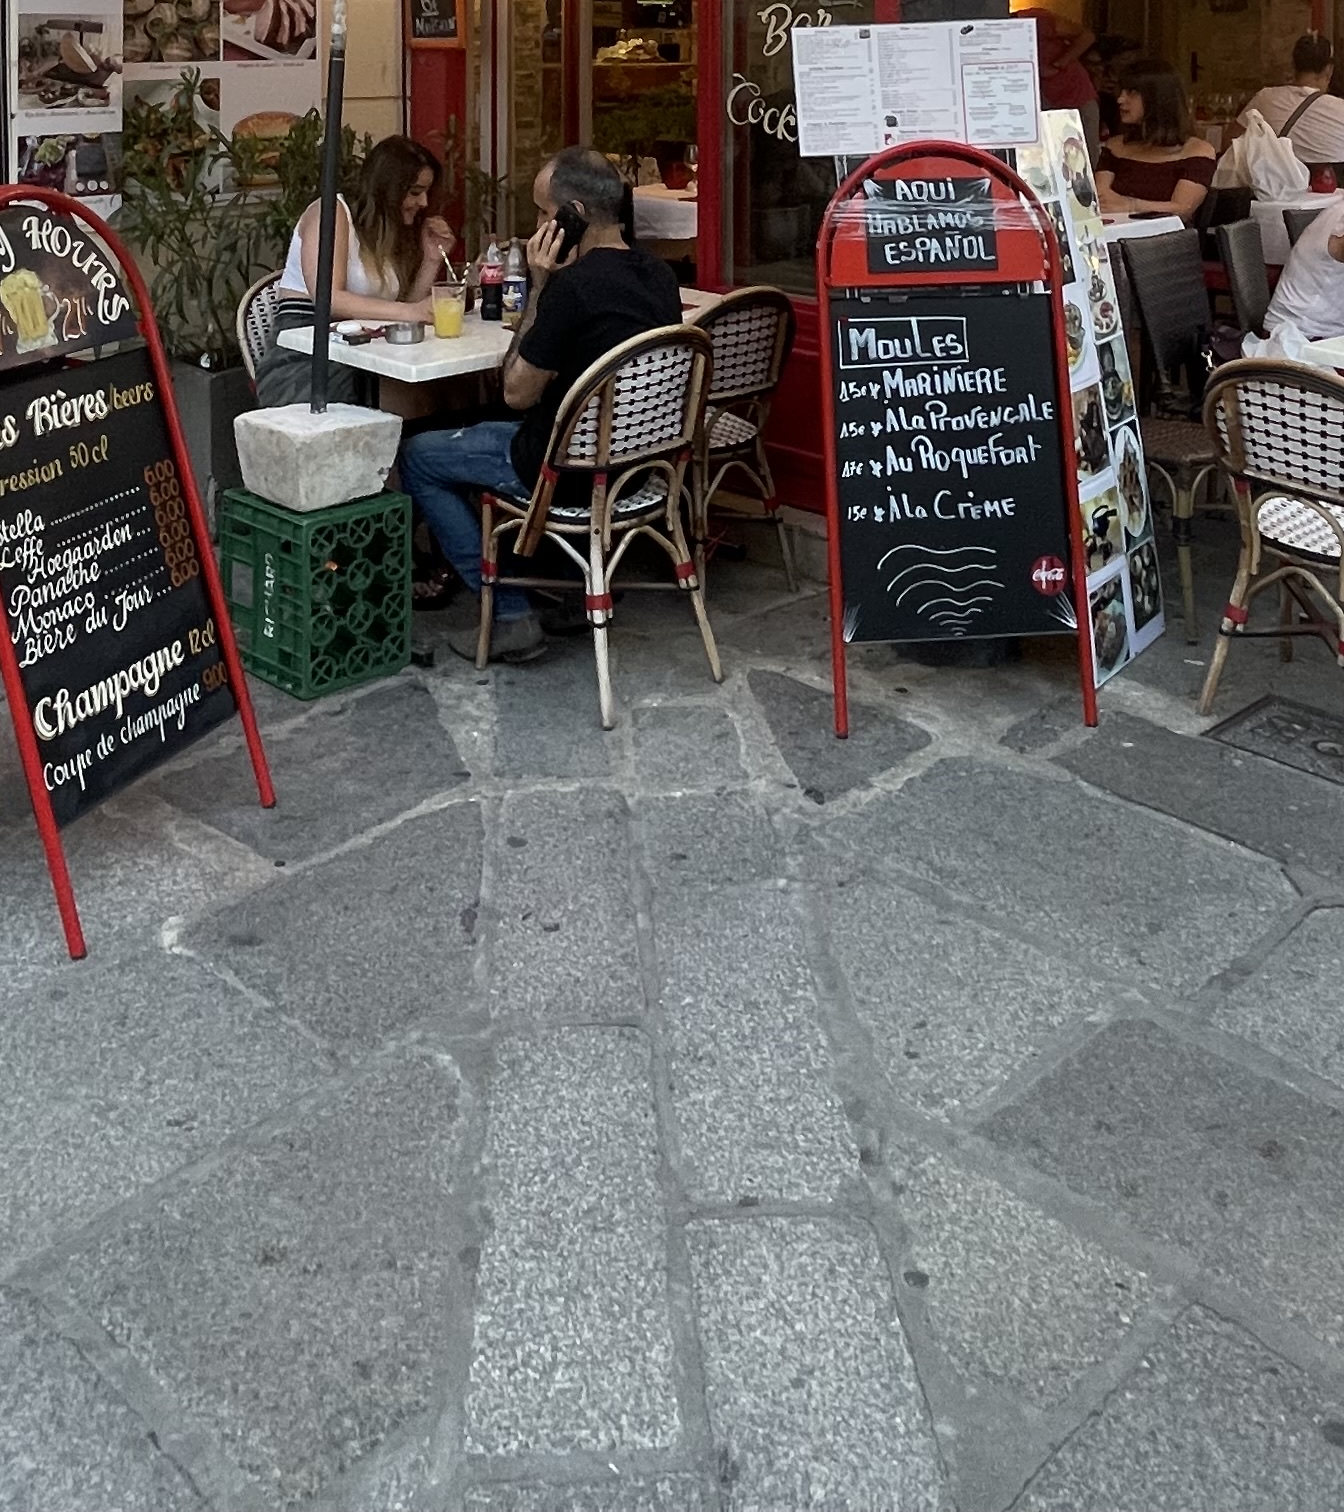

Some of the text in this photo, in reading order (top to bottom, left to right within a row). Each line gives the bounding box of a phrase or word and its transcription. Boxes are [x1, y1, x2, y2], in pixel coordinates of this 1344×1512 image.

[22, 216, 130, 324] HOURS
[27, 522, 133, 584] Hoegaarden
[11, 591, 96, 645] Monaco
[18, 623, 77, 669] Bière
[85, 605, 108, 634] du
[112, 584, 154, 633] Jour
[34, 639, 186, 742] Champagne
[43, 748, 92, 792] Coupe
[96, 732, 116, 760] de
[119, 682, 202, 743] champagne
